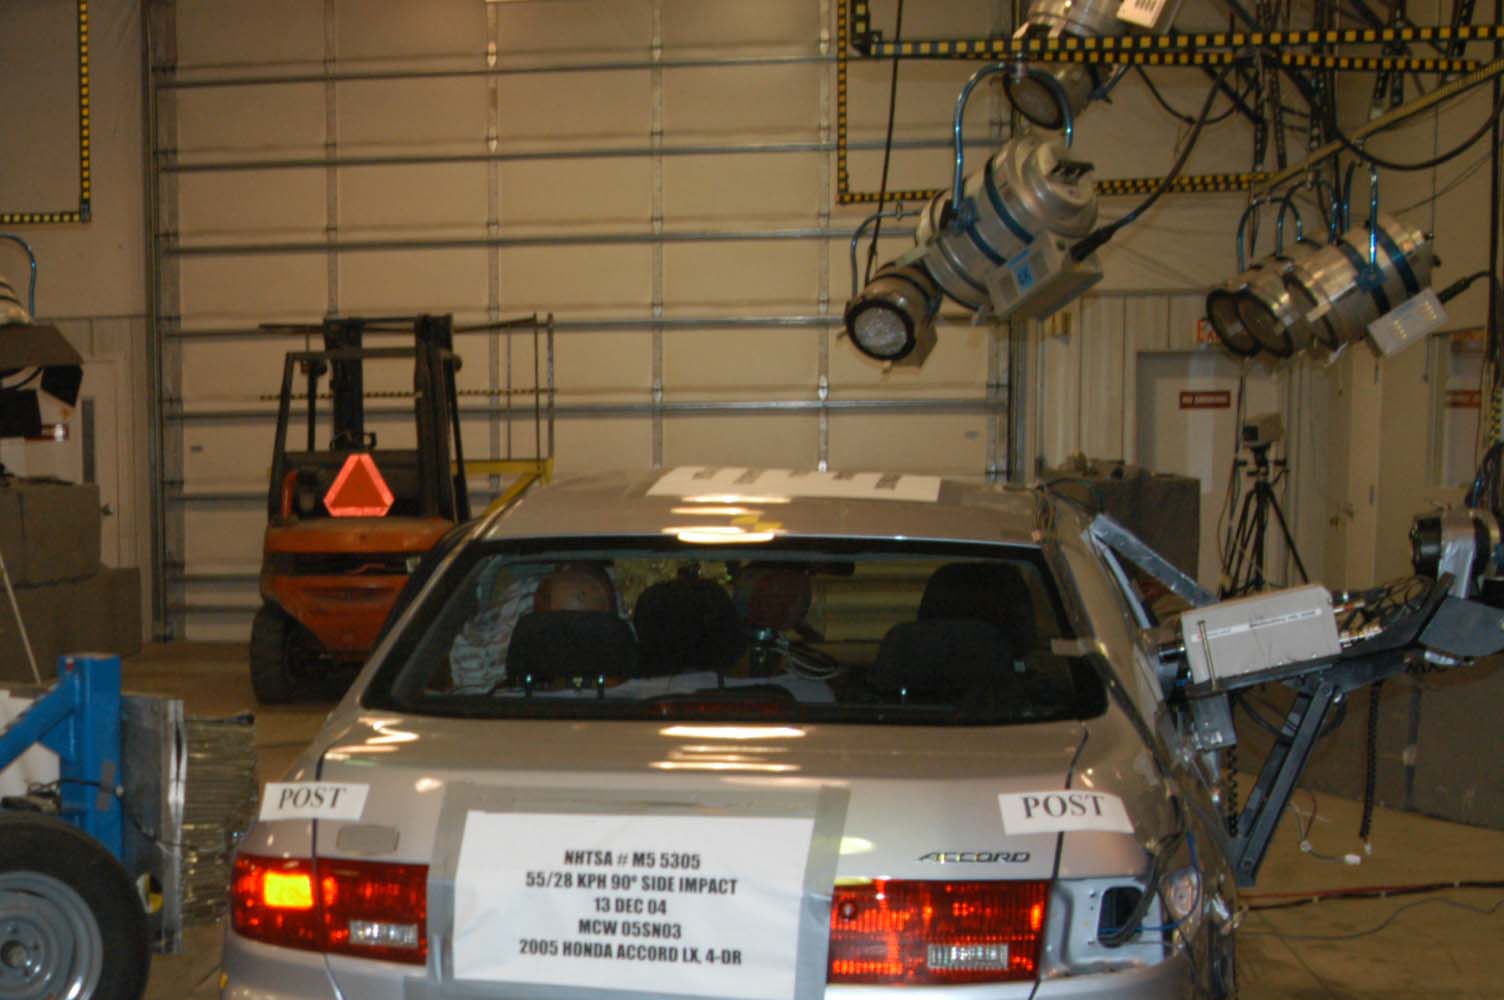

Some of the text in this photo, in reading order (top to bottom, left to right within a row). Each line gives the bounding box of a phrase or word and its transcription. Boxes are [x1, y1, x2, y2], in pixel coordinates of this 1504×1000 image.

[278, 787, 347, 810] POST
[1022, 794, 1104, 818] POST
[564, 850, 700, 870] NHTSA # M5 5305
[918, 851, 1031, 863] ACCORD
[526, 871, 573, 888] 55/28
[577, 873, 607, 889] KPH
[641, 876, 674, 892] SIDE
[679, 877, 738, 895] IMPACT
[594, 897, 667, 915] 13 DEC 04
[578, 919, 682, 939] MCW 05SN03
[519, 939, 558, 956] 2005
[562, 941, 613, 959] HONDA
[616, 944, 678, 963] ACCORD
[705, 948, 742, 966] 4-DR
